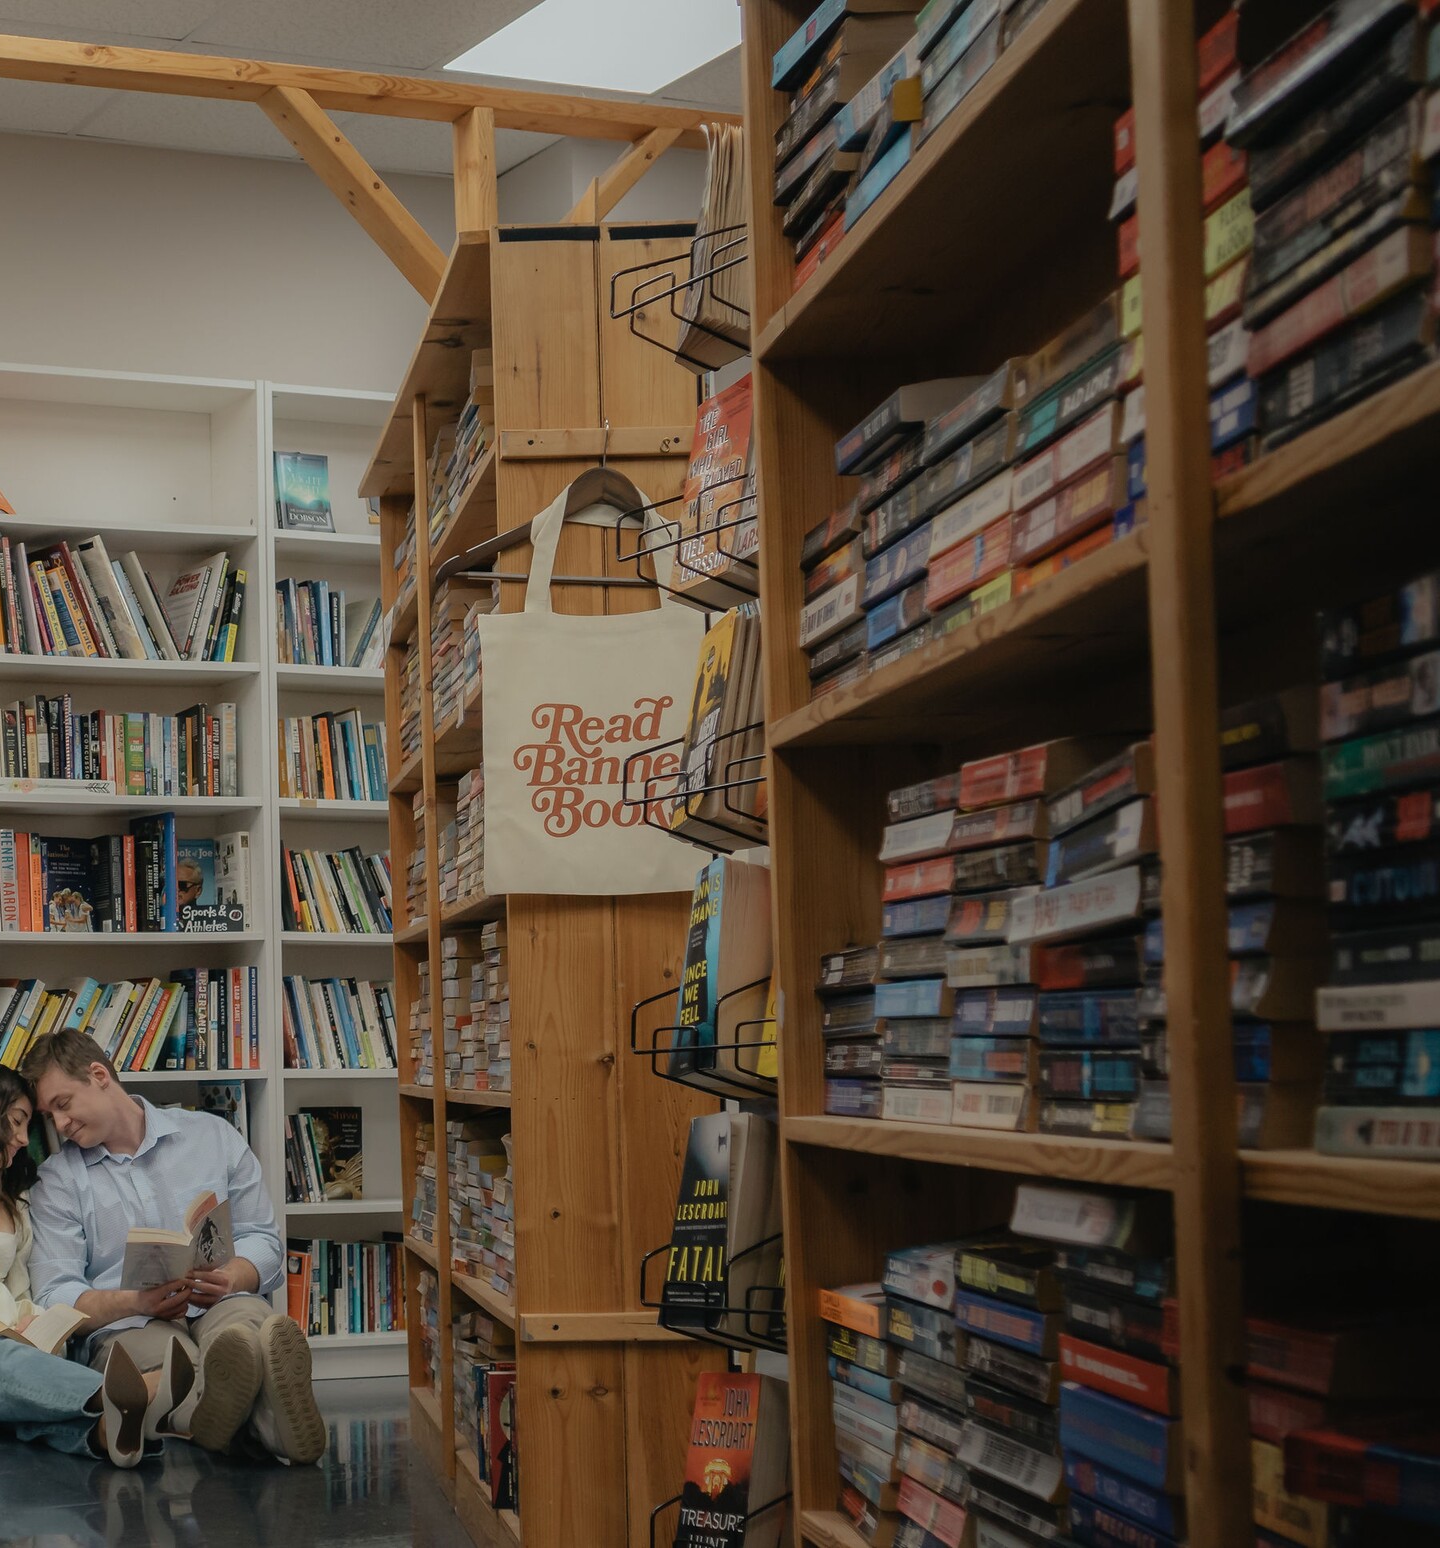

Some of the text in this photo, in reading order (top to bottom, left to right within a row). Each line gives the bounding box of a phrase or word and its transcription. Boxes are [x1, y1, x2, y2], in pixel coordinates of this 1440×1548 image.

[699, 407, 721, 436] THE
[705, 423, 730, 452] GIRL
[689, 453, 713, 480] WHO
[703, 458, 743, 488] PLAYED
[289, 512, 326, 523] DOBSON
[232, 592, 242, 614] Sailing
[78, 618, 93, 650] Karate
[531, 696, 673, 758] Read
[199, 848, 213, 859] Joe
[0, 831, 16, 922] HENRY AARON
[182, 904, 227, 920] Sports &
[184, 920, 228, 932] Athletes
[198, 971, 207, 1034] UNDERLAND
[322, 990, 334, 1022] RADICAL
[684, 983, 699, 1005] WE
[680, 1005, 700, 1027] FELL
[329, 1111, 359, 1120] Shiva
[694, 1178, 720, 1198] JOHN
[676, 1200, 728, 1222] LESCROART
[667, 1245, 724, 1282] FATAL
[722, 1387, 751, 1417] JOHN
[691, 1418, 753, 1450] LESCROART
[681, 1508, 745, 1533] TREASURE
